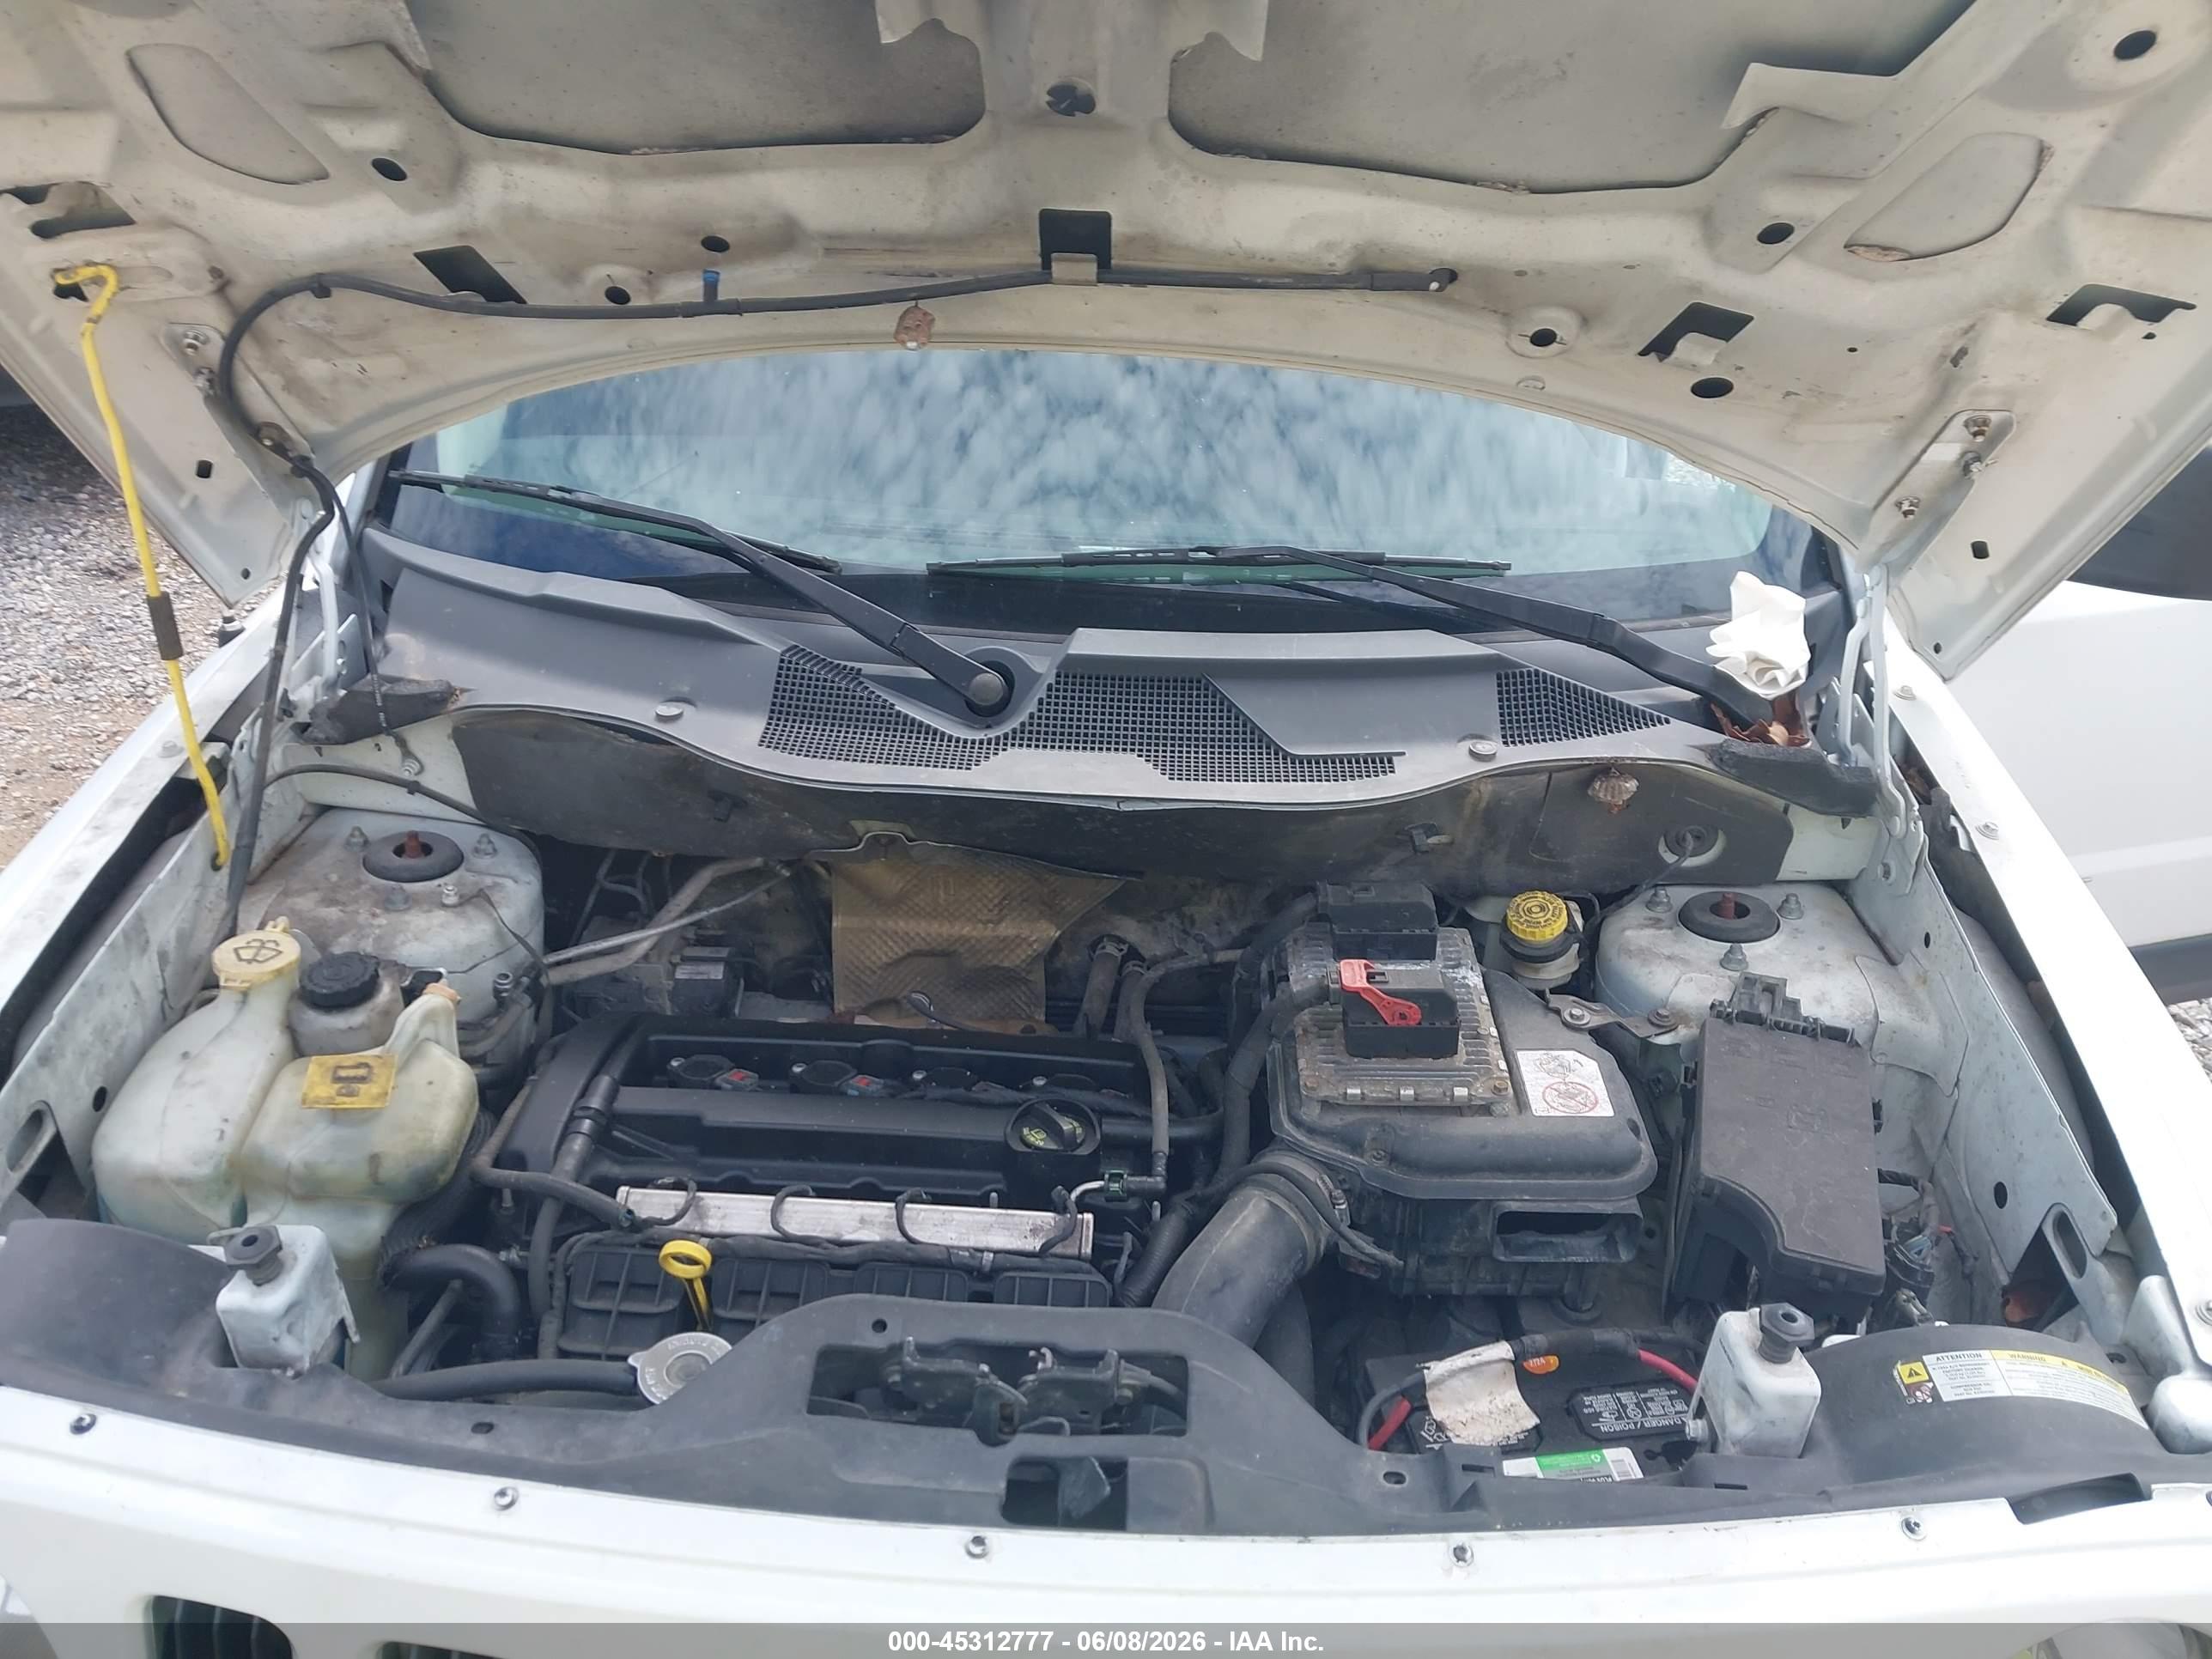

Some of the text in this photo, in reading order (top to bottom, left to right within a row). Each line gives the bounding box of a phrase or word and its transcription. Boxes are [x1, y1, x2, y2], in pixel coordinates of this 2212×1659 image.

[1936, 1352, 1983, 1362] ATTENTION
[2008, 1352, 2047, 1363] WARNING
[1600, 1422, 1636, 1433] POISON
[1644, 1418, 1682, 1428] DANGER
